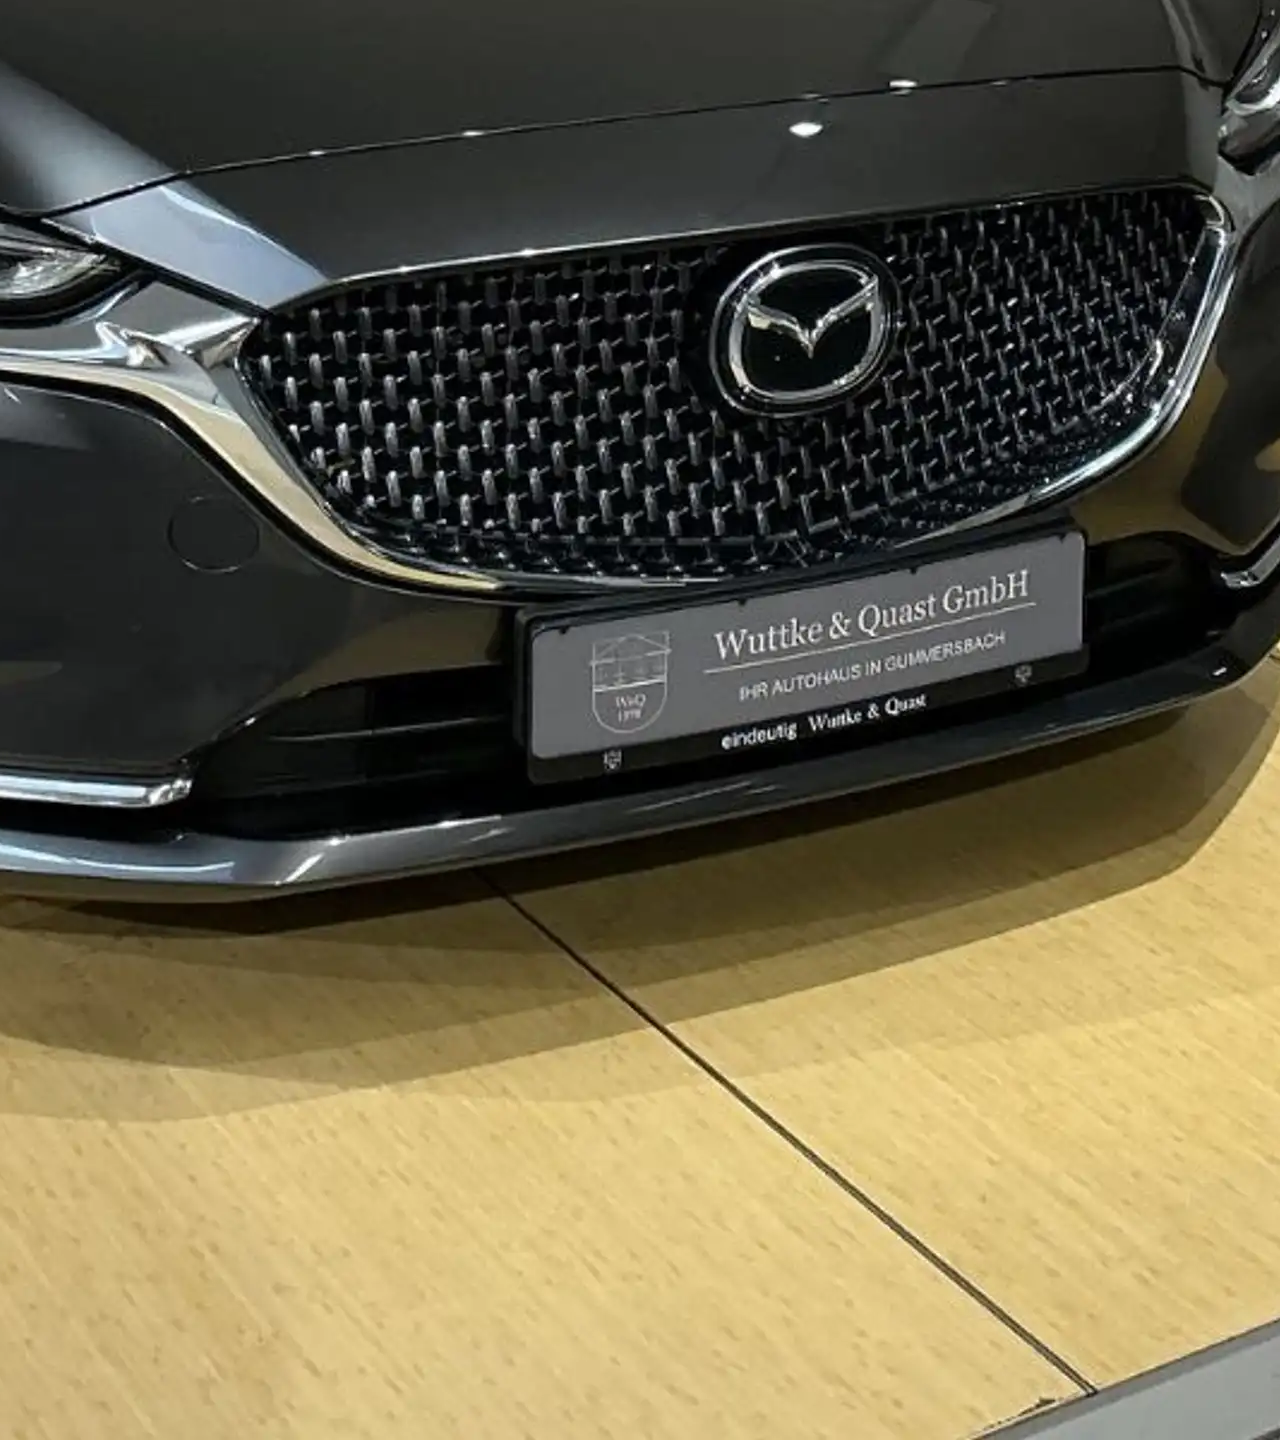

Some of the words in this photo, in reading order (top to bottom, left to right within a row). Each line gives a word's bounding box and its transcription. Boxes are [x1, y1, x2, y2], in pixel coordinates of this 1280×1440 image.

[713, 617, 824, 661] Wuttke
[828, 610, 852, 640] &
[858, 592, 937, 637] Quast
[942, 570, 1029, 614] GmbH
[739, 681, 769, 702] IHR
[772, 663, 862, 696] AUTOHAUS
[865, 660, 882, 677] IN
[884, 630, 1007, 671] GUMMERSBACH
